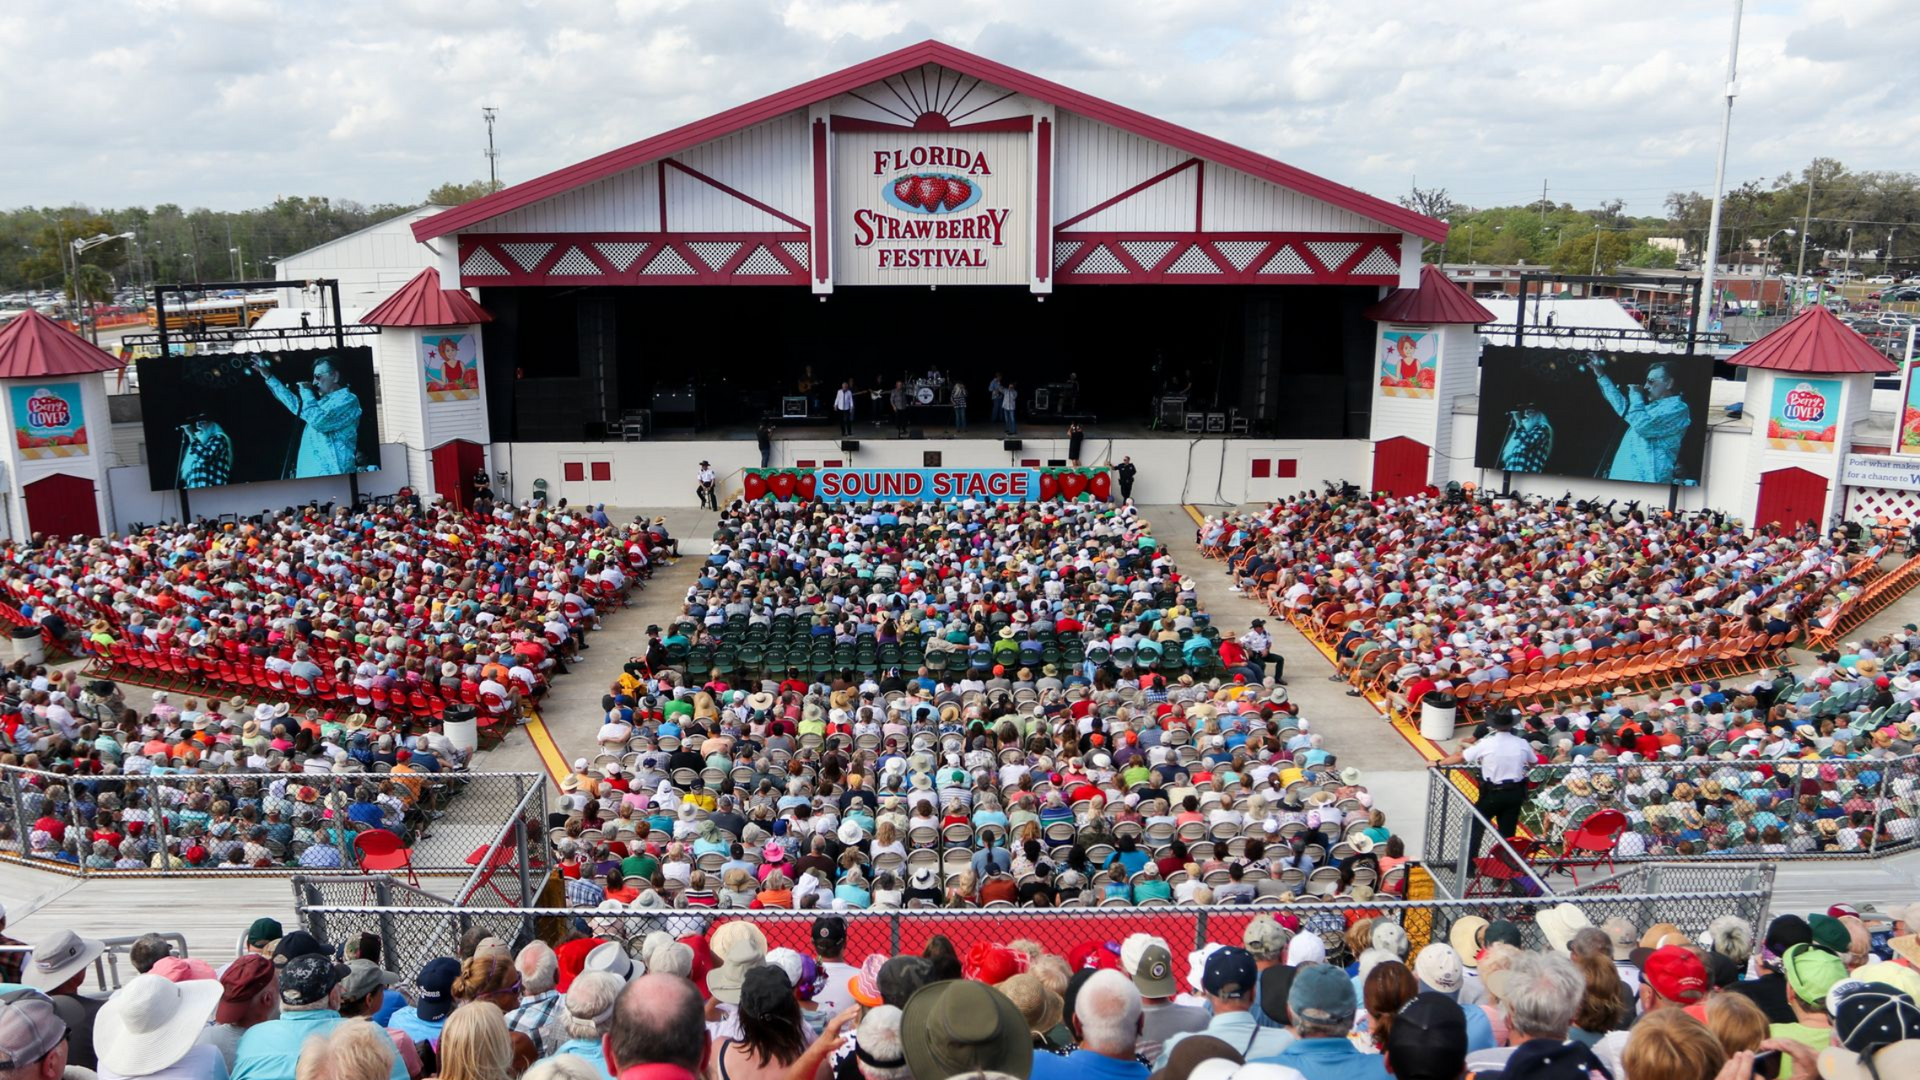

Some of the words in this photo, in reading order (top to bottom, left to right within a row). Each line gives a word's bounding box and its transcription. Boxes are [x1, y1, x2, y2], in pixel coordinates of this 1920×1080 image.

[874, 146, 991, 175] FLORIDA
[854, 209, 1009, 246] STRAWBERRY
[878, 249, 987, 267] FESTIVAL
[32, 400, 63, 412] Berry
[1790, 393, 1820, 406] Berry
[32, 411, 67, 425] LOVER
[1786, 405, 1820, 419] LOVER
[1849, 459, 1867, 467] Post
[1870, 460, 1891, 469] what
[1893, 462, 1920, 470] makes
[1847, 471, 1859, 479] for
[1868, 473, 1898, 481] chance
[822, 471, 923, 496] SOUND
[933, 471, 1028, 496] STAGE
